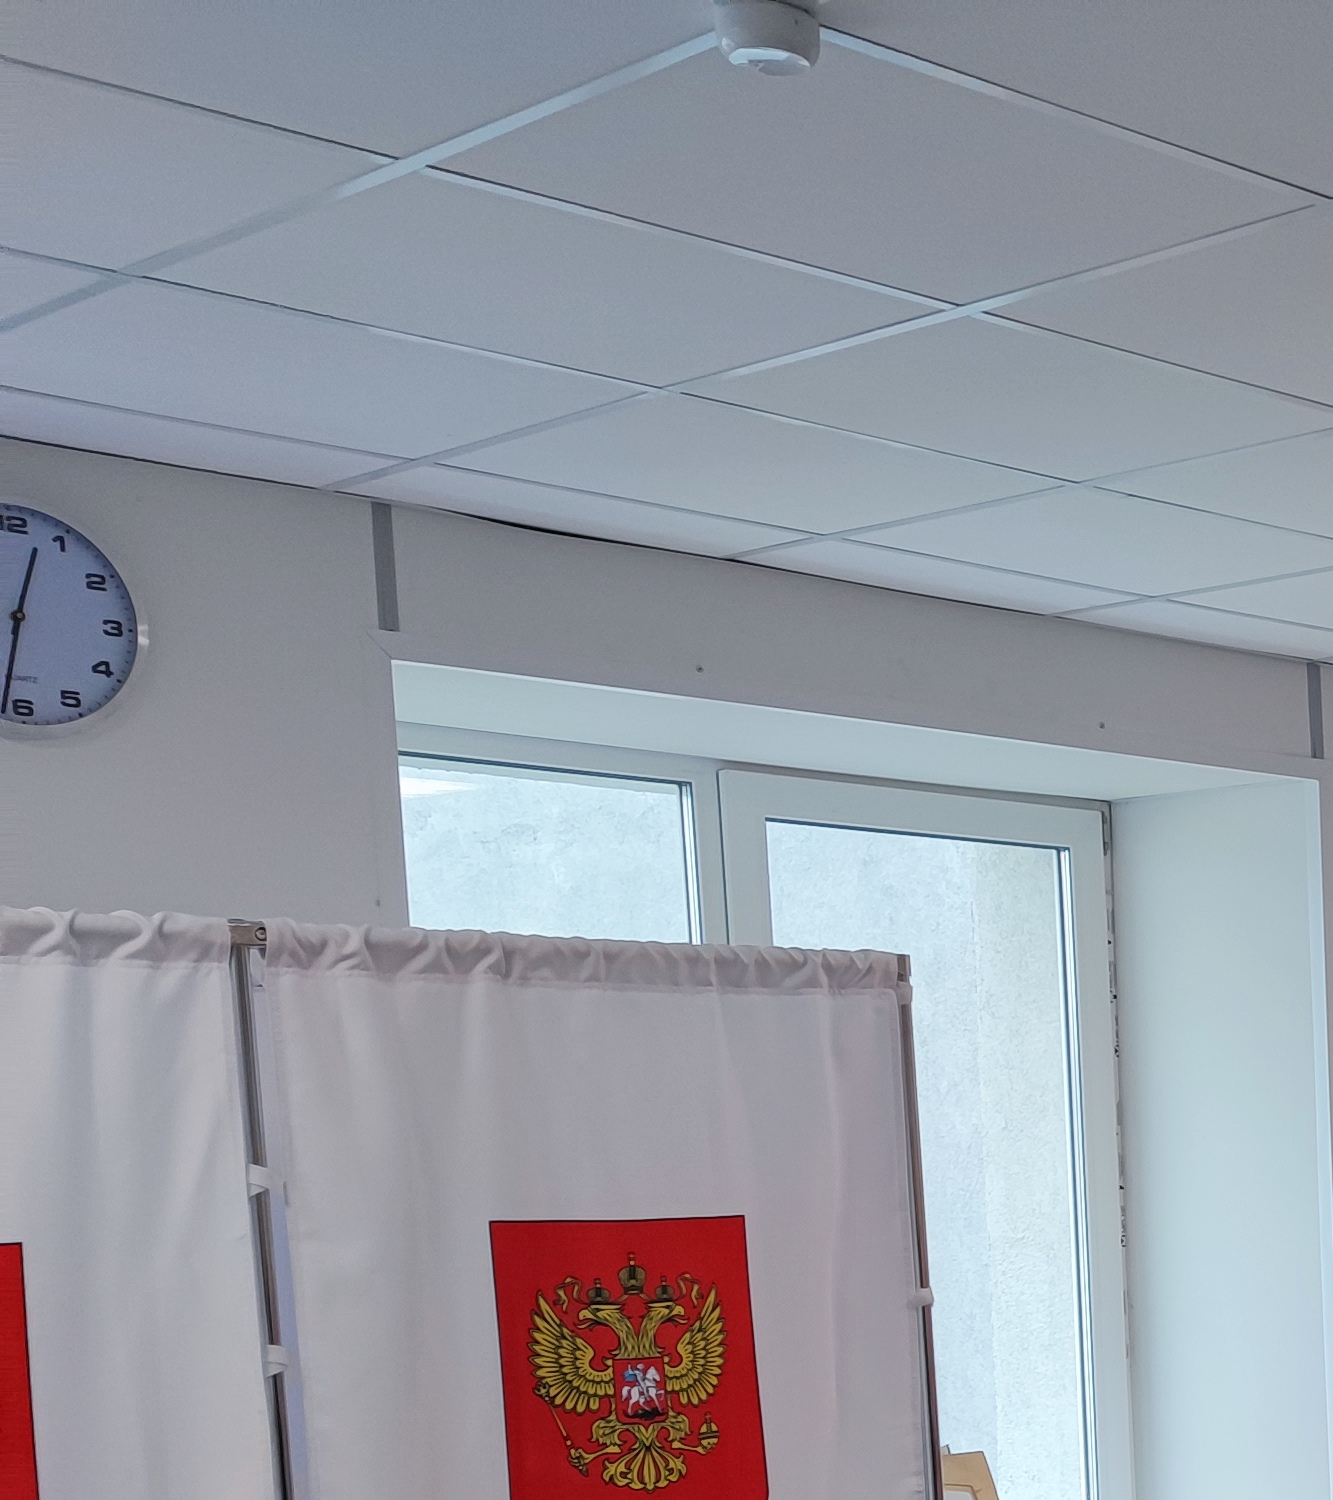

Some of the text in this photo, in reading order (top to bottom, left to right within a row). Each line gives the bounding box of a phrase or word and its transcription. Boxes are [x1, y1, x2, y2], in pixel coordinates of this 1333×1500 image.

[52, 535, 66, 553] 1
[85, 573, 108, 592] 2
[102, 619, 124, 638] 3
[91, 660, 114, 678] 4
[60, 689, 82, 708] 5
[12, 699, 34, 717] 6
